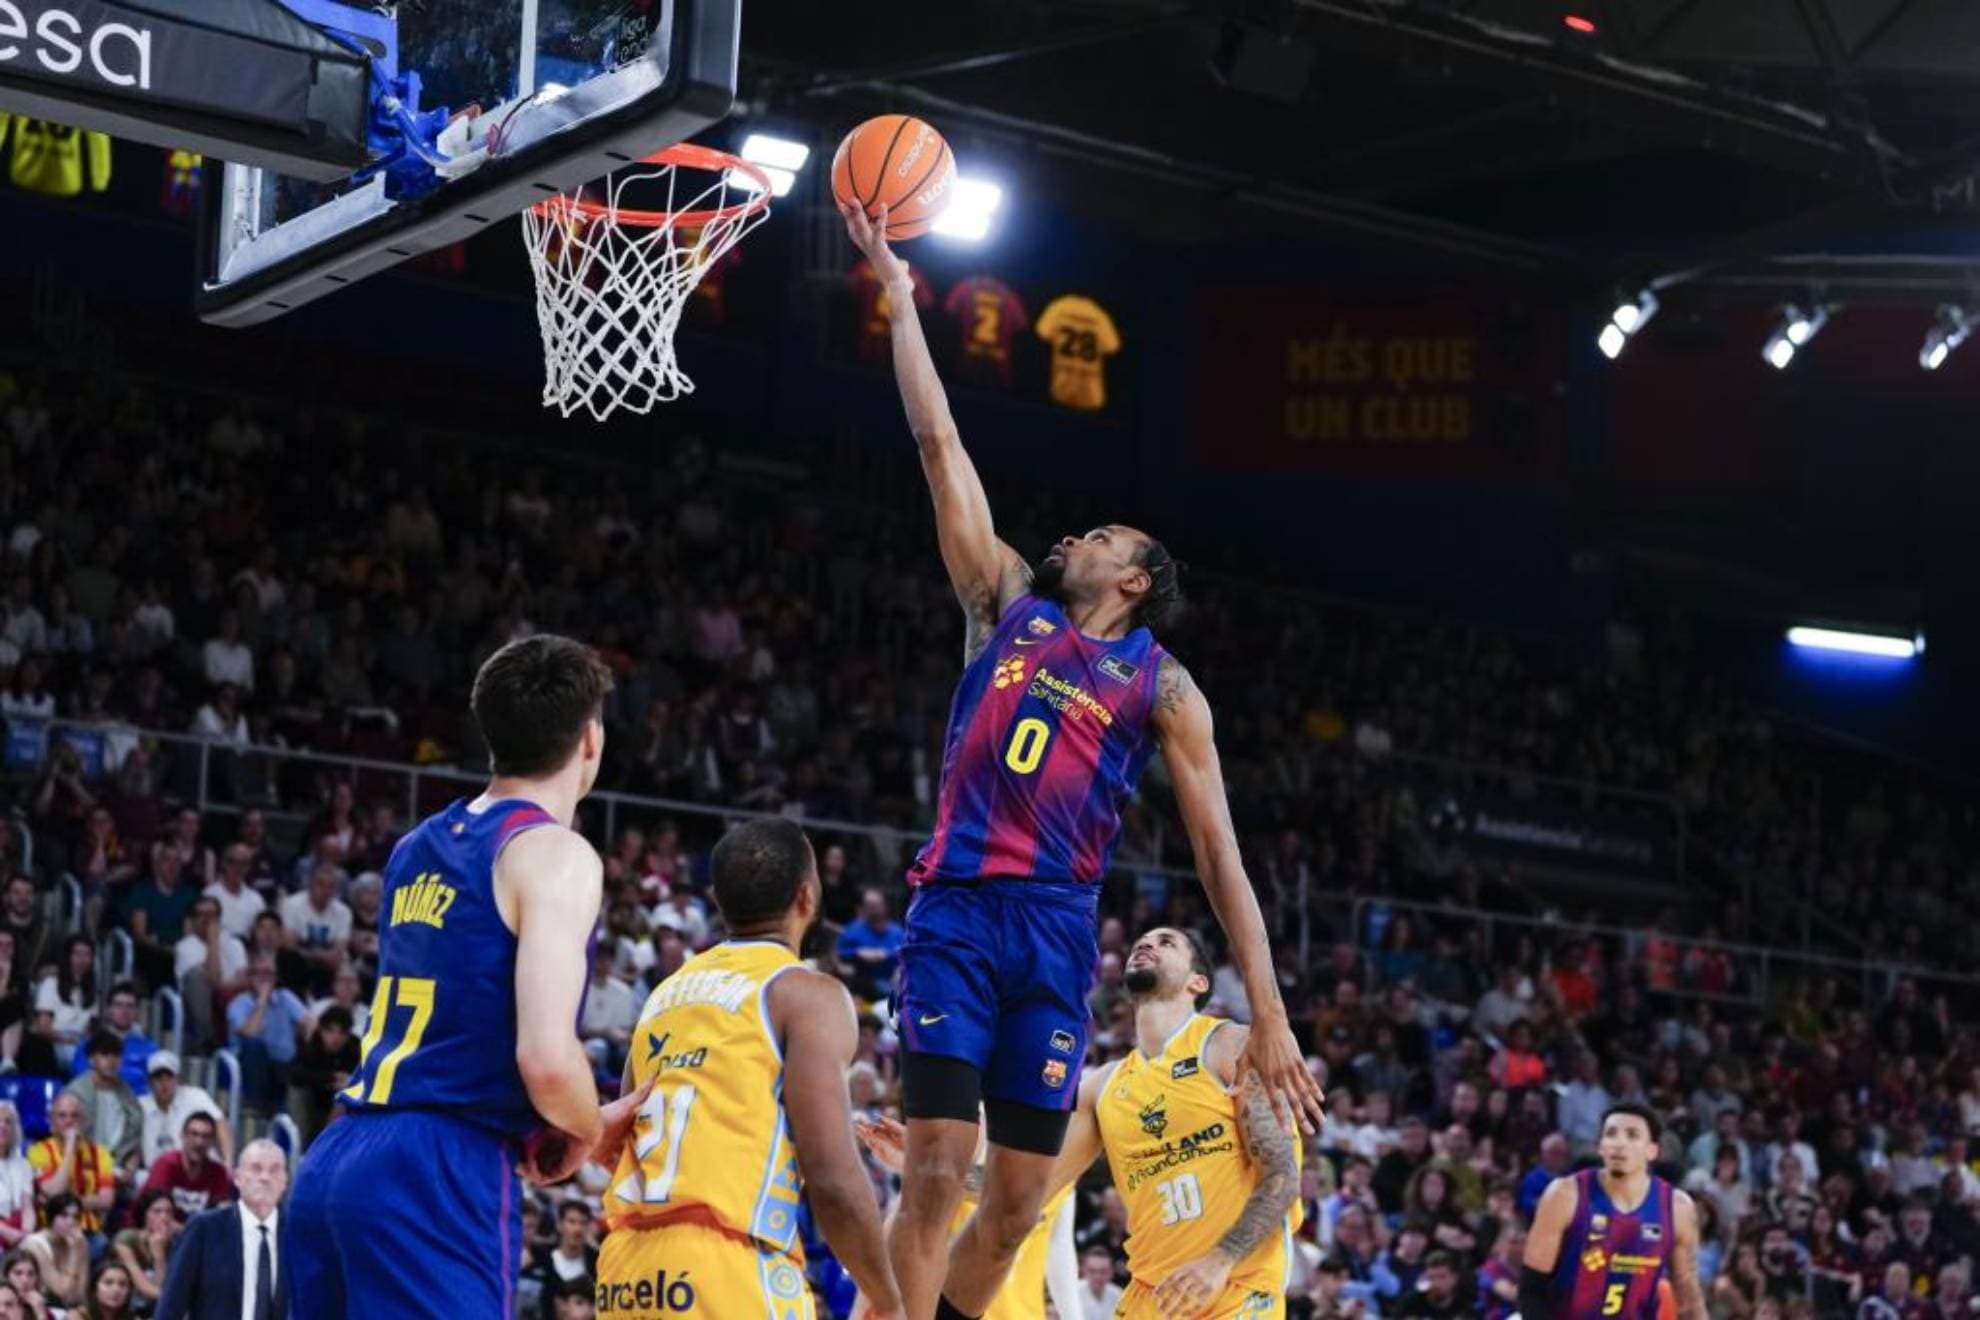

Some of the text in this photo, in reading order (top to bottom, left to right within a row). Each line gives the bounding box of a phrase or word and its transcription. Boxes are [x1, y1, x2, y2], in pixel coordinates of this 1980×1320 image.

[1286, 320, 1473, 391] MÉS QUE
[1285, 396, 1471, 439] UN CLUB
[1005, 718, 1050, 775] 0
[1157, 1172, 1204, 1226] 30
[1602, 1283, 1627, 1316] 5
